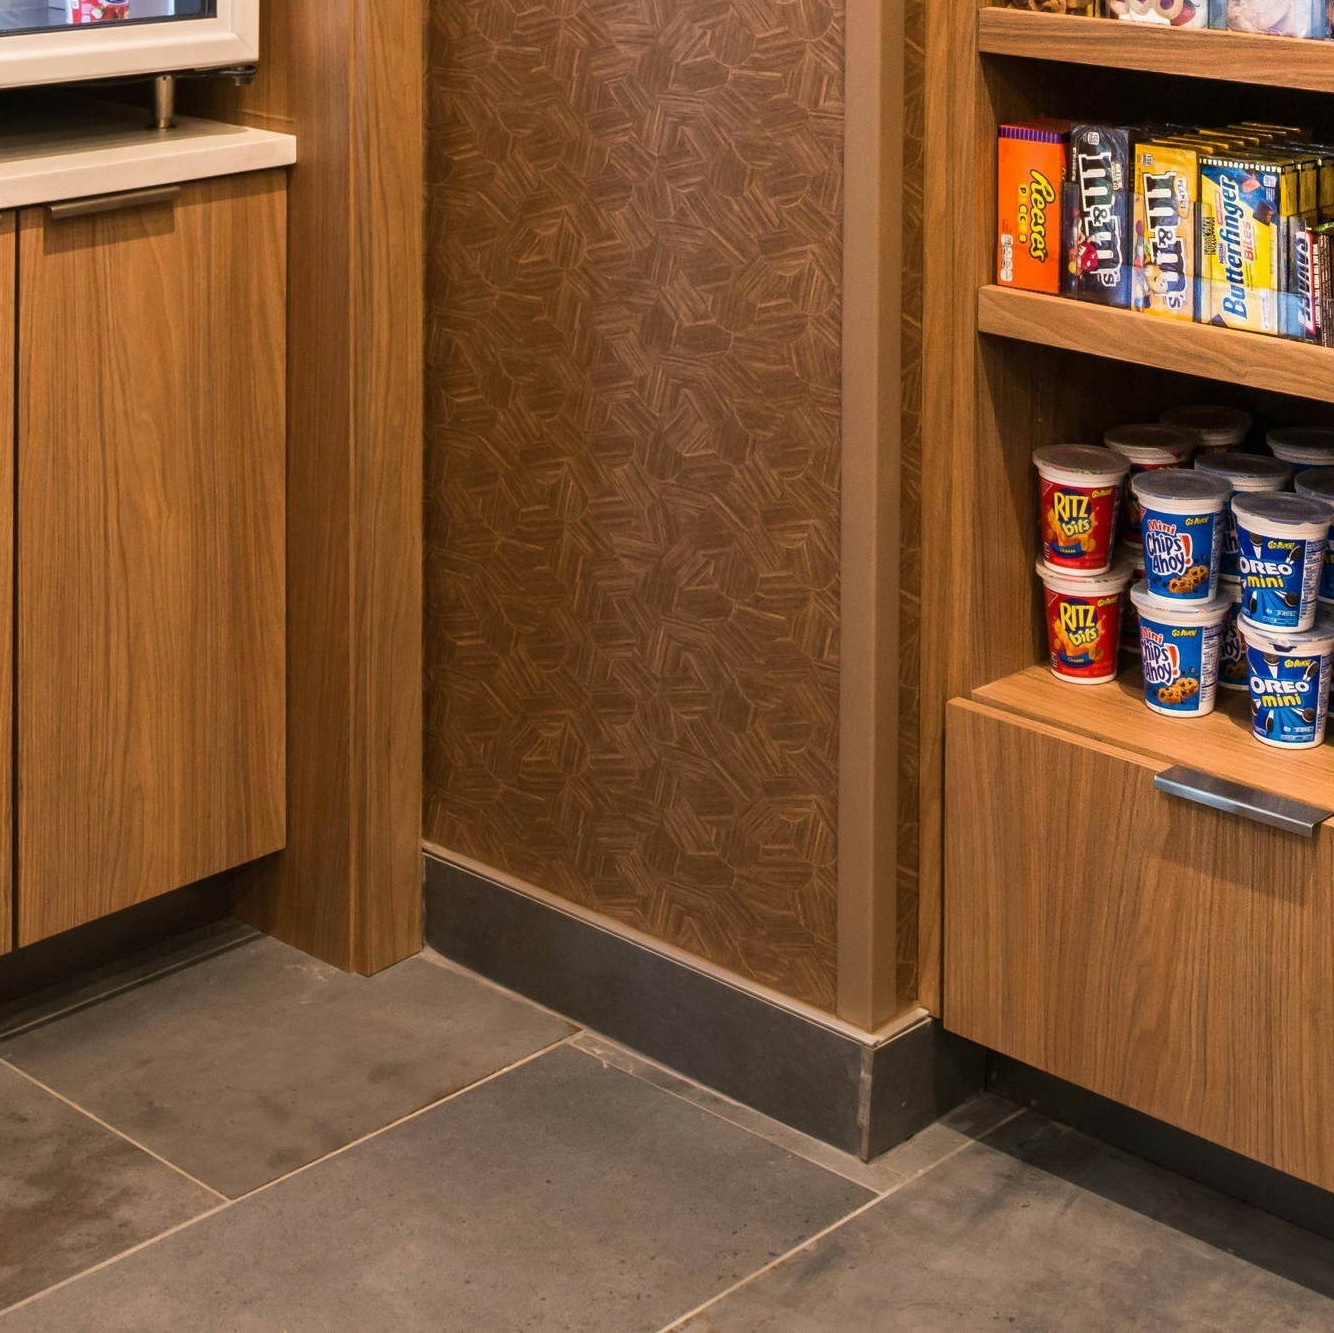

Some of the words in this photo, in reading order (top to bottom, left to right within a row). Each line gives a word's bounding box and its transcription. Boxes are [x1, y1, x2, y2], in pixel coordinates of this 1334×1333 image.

[1029, 169, 1056, 263] Reese's
[1222, 174, 1247, 321] Butterfinger
[1243, 220, 1255, 262] Bites
[1054, 492, 1089, 520] RITZ
[1061, 518, 1092, 537] bits
[1147, 519, 1177, 534] Mini
[1146, 532, 1182, 561] Chips
[1239, 557, 1293, 576] OREO
[1247, 574, 1284, 589] mini
[1060, 601, 1095, 630] RITZ
[1068, 628, 1099, 646] bits
[1250, 678, 1310, 696] OREO
[1262, 691, 1302, 708] mini
